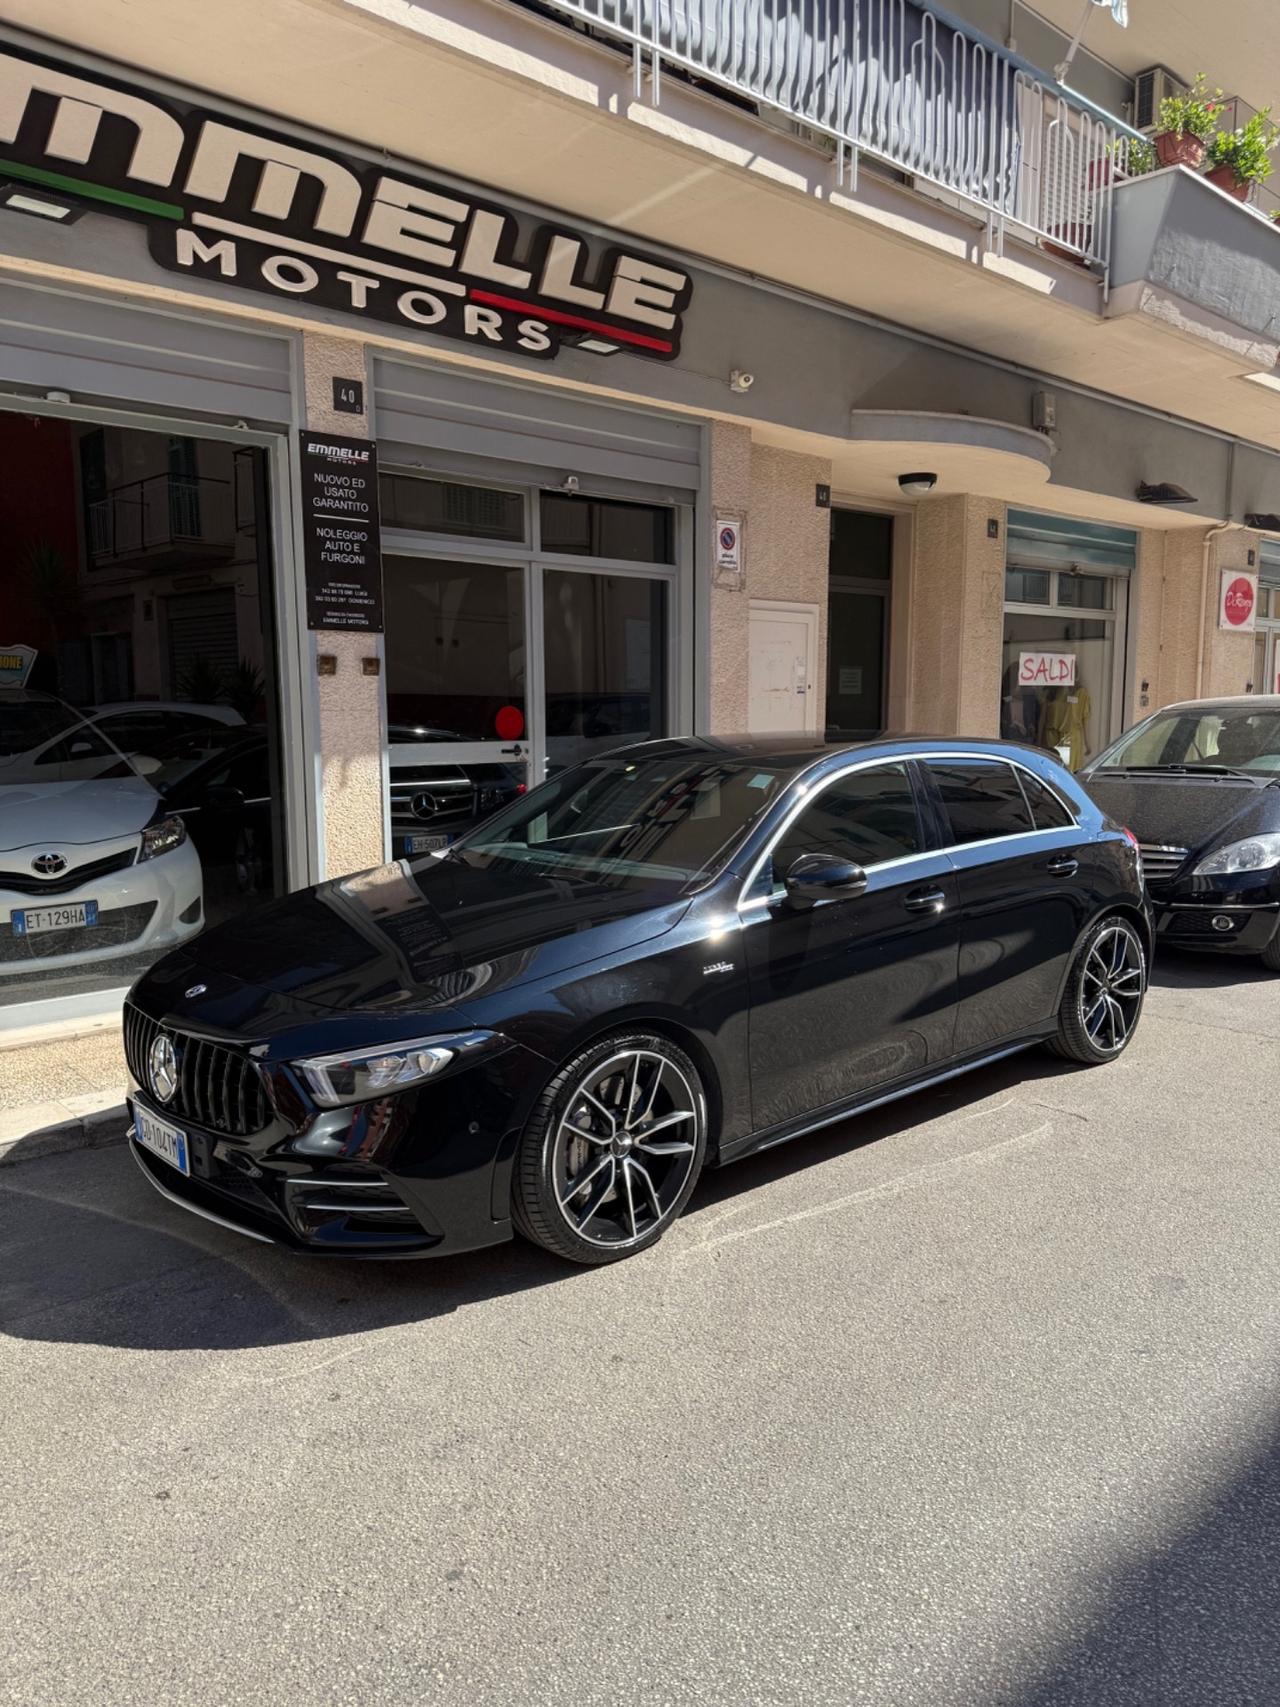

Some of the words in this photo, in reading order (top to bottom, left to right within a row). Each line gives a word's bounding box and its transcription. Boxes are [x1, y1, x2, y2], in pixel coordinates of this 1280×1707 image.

[176, 228, 551, 351] MOTORS
[341, 388, 355, 403] 40
[307, 443, 370, 461] EMMELLE
[313, 473, 350, 486] NUOVO
[352, 478, 366, 488] ED
[324, 486, 357, 499] USATO
[312, 497, 369, 513] GARANTITO
[316, 527, 368, 542] NOLEGGIO
[324, 540, 352, 552] AUTO
[353, 543, 360, 552] E
[321, 551, 366, 565] FURGONI
[1021, 657, 1074, 682] SALDI
